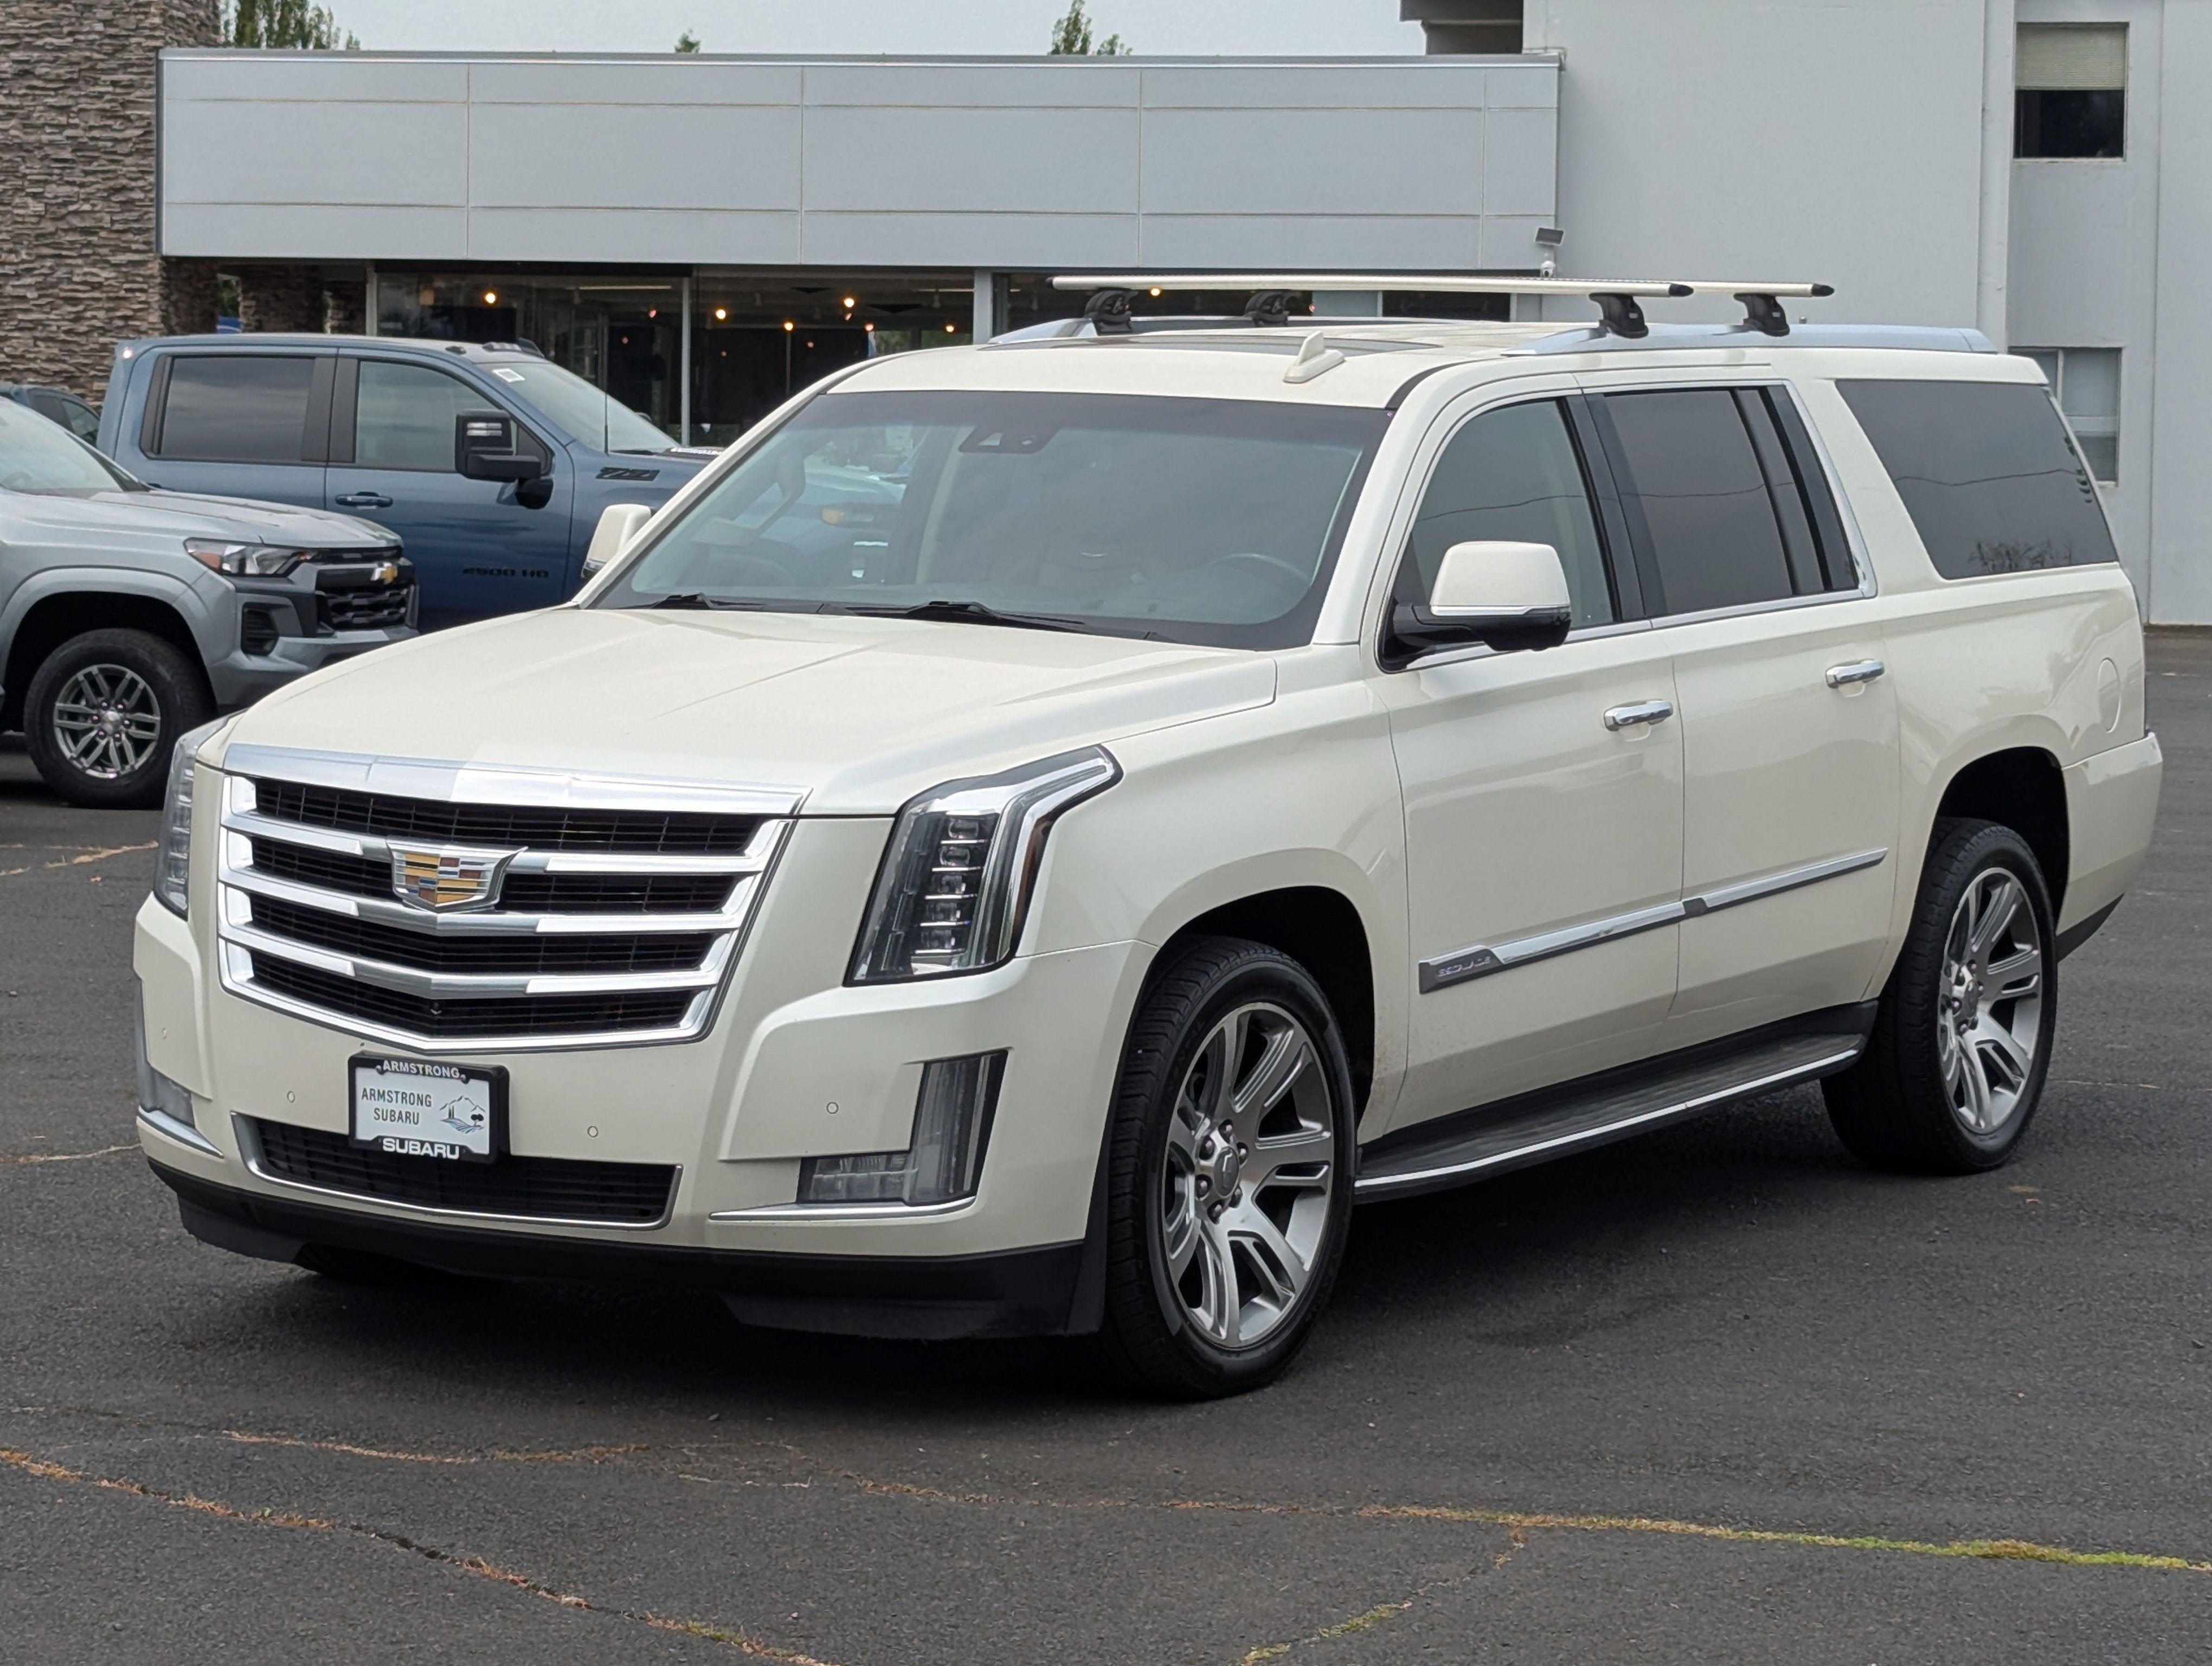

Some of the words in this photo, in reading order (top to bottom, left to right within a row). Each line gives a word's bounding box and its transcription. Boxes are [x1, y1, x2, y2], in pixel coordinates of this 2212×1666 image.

[383, 1060, 460, 1078] ARMSTRONG
[361, 1087, 433, 1107] ARMSTRONG
[373, 1107, 420, 1125] SUBARU
[382, 1138, 460, 1160] SUBARU
